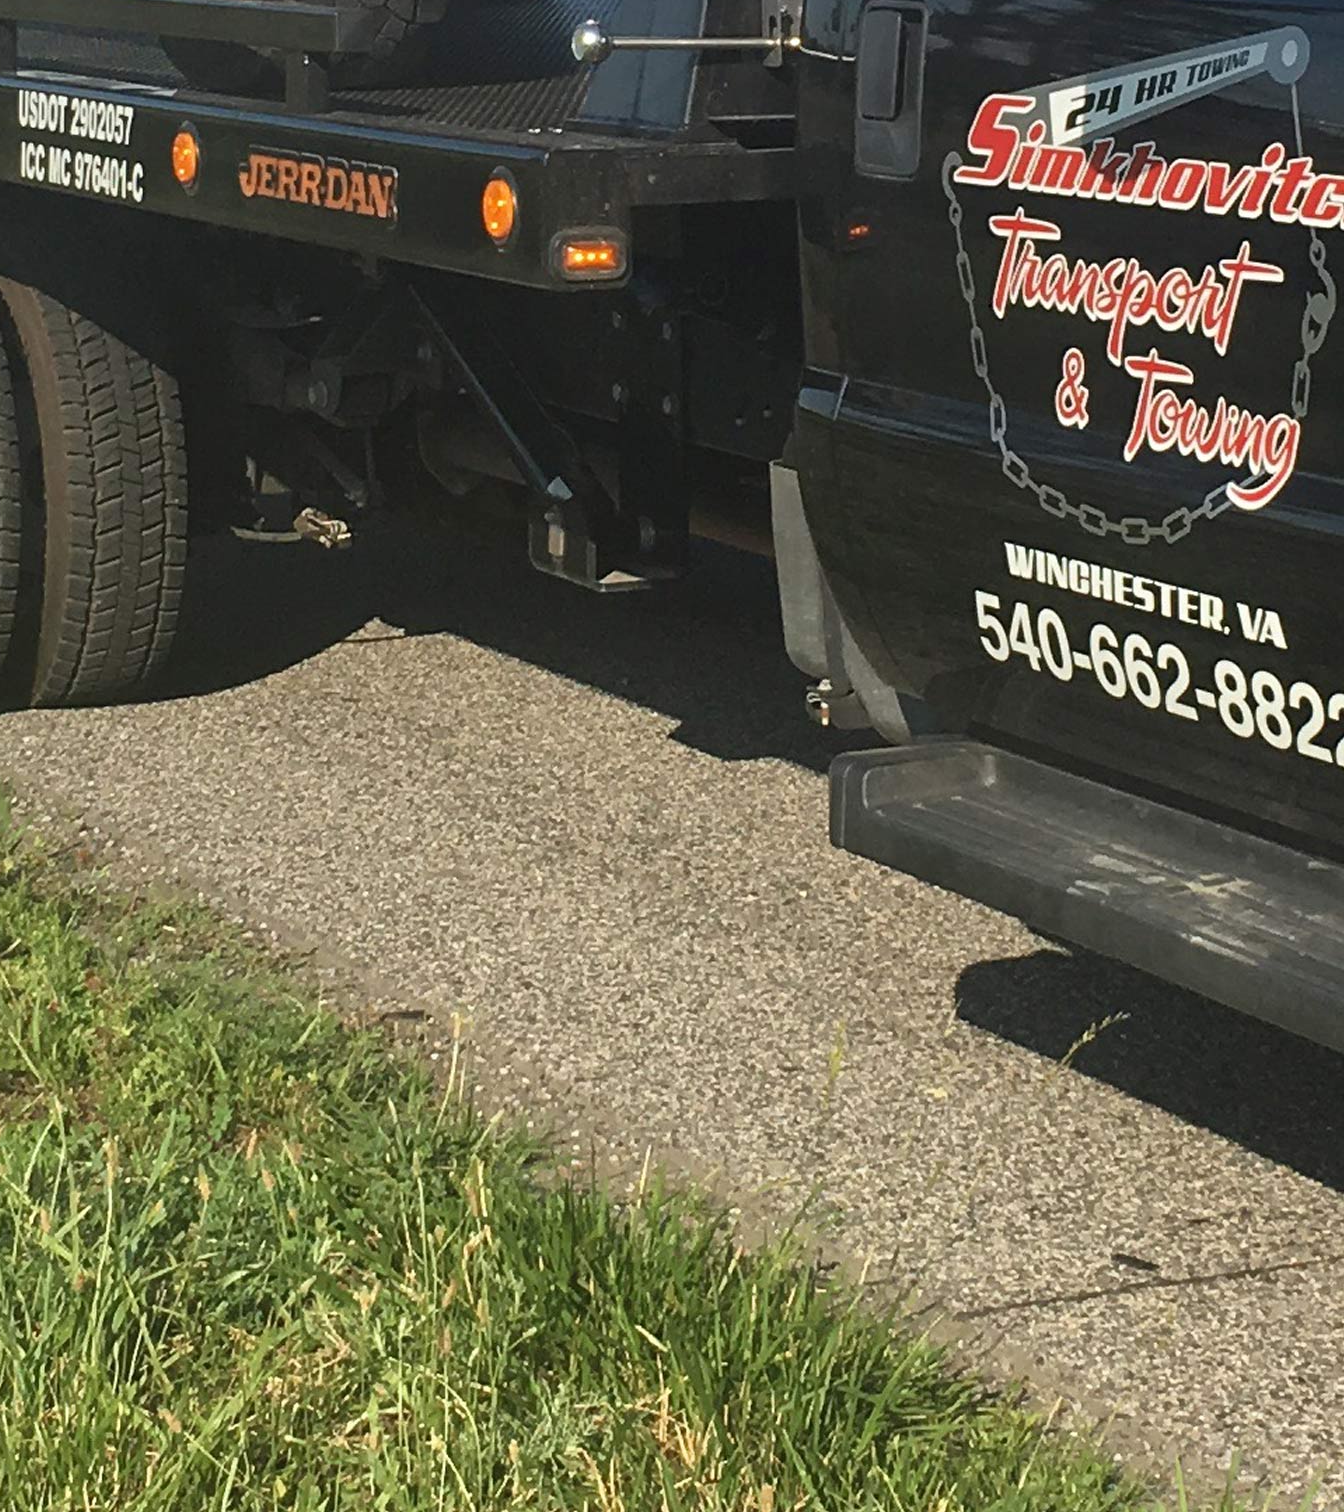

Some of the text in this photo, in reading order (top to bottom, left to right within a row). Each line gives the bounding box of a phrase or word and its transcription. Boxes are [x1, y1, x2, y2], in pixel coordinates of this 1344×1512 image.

[19, 89, 134, 145] USDOT 2902057
[1065, 50, 1250, 131] 24 HR TOWING
[21, 141, 144, 203] ICC MC 976401-C
[989, 206, 1284, 366] Transport
[1055, 347, 1301, 510] & Towing
[1004, 541, 1289, 650] WINCHESTER, VA
